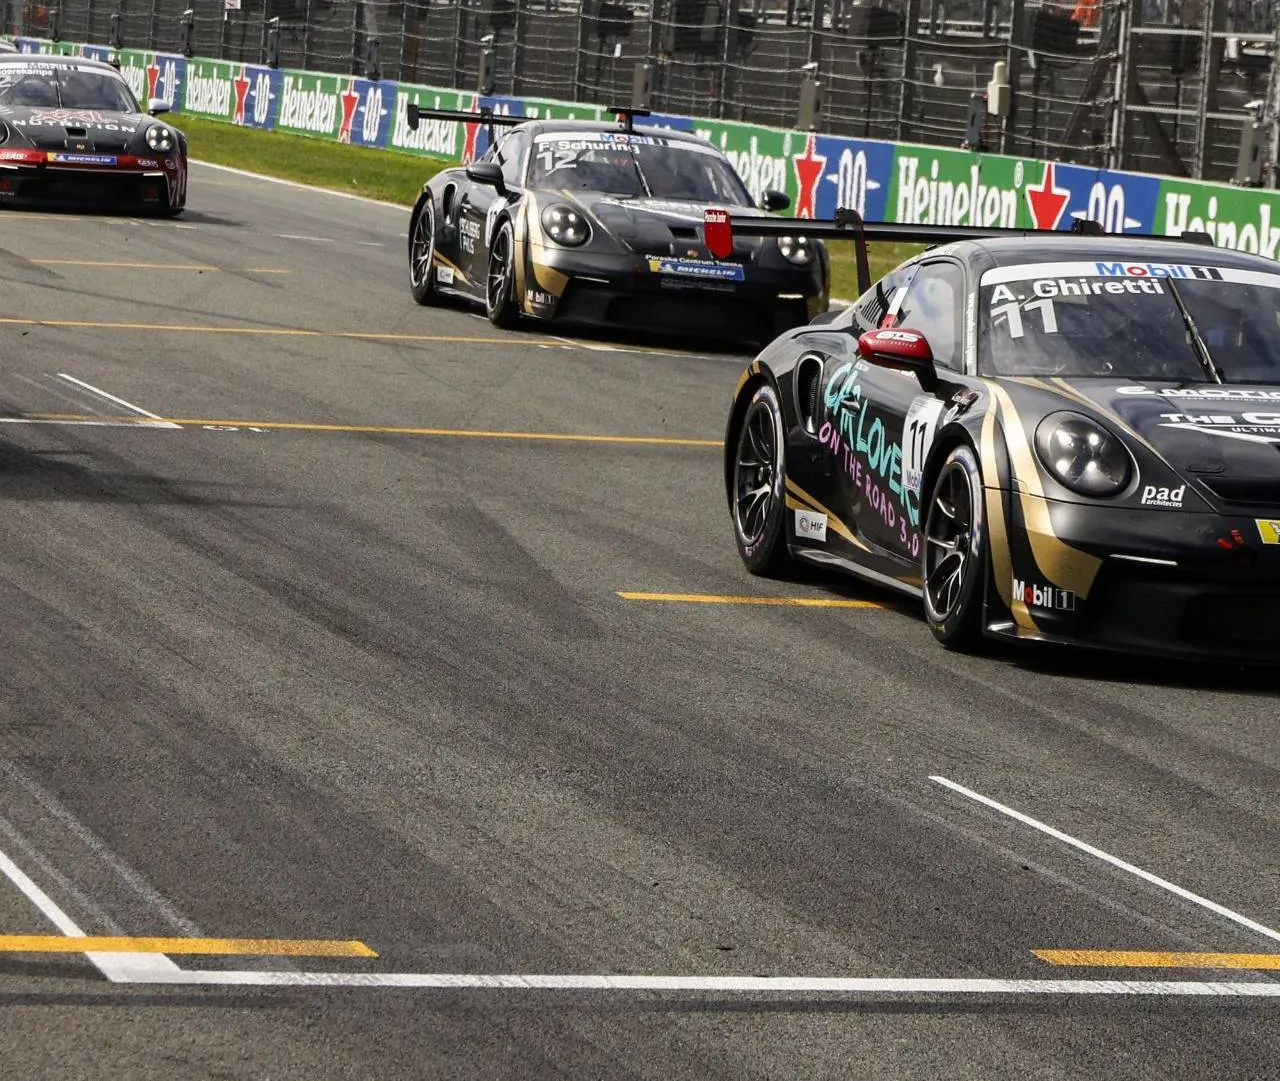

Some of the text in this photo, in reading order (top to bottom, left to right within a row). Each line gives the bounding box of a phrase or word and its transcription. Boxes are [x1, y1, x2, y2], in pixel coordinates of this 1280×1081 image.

[186, 63, 230, 117] Heineken
[279, 76, 338, 134] Heineken
[13, 120, 137, 133] NUTRITION
[538, 141, 640, 154] F. Schuring
[600, 133, 653, 145] Mobil
[536, 151, 577, 171] 12
[645, 254, 678, 263] Porsche
[679, 256, 714, 266] Centrum
[677, 265, 736, 276] MICHELIN
[1094, 262, 1188, 278] Mobil
[991, 278, 1164, 305] A. Ghiretti
[990, 298, 1058, 339] 11
[1160, 413, 1235, 424] THE
[909, 419, 928, 473] 11
[818, 421, 841, 455] ON
[844, 441, 862, 487] THE
[866, 476, 896, 528] ROAD
[1141, 485, 1186, 504] pad
[1012, 578, 1053, 609] Mobil
